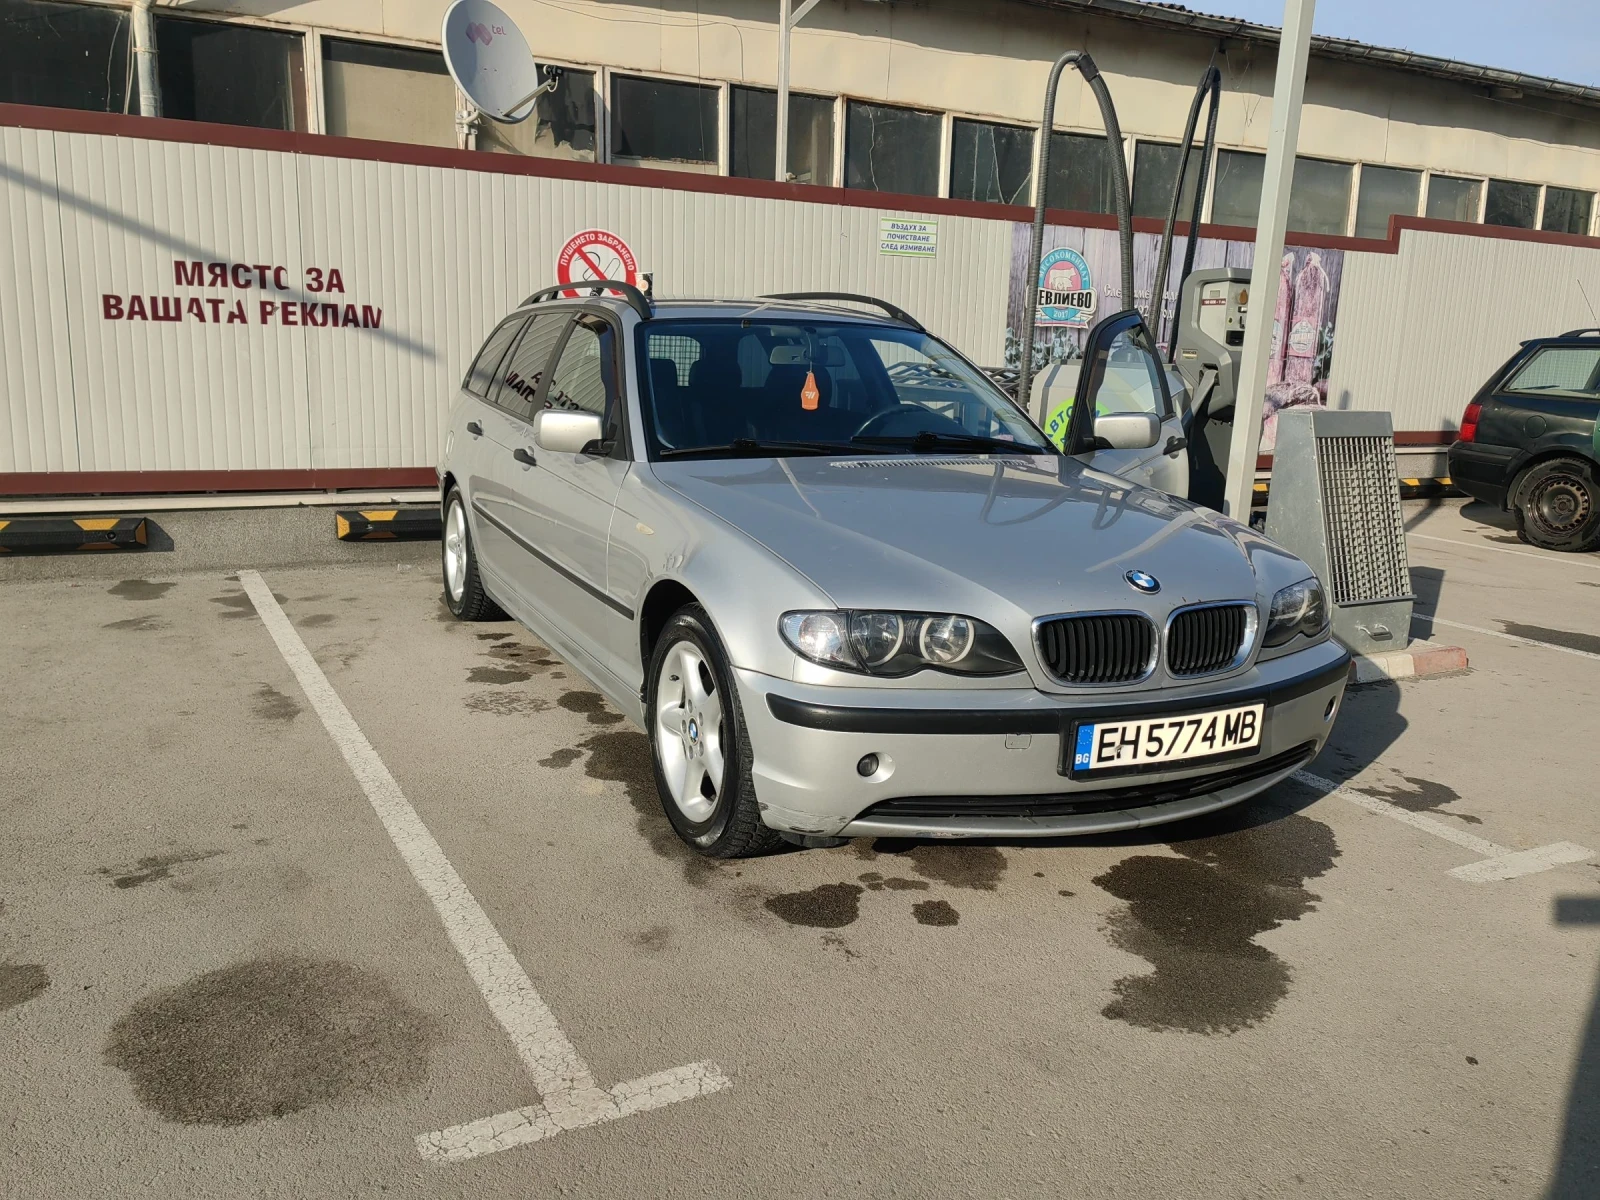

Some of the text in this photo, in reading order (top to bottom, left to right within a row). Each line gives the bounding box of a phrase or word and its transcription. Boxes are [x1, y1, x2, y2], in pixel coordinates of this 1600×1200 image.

[890, 222, 918, 231] ВЪЗДУХ
[886, 232, 930, 242] ПОЧИСТВАНЕ
[560, 233, 635, 271] ПУШЕНЕТО ЗАБРАНЕНО
[880, 243, 936, 253] СЛЕД ИЗМИВАНЕ
[305, 266, 346, 294] ЗА
[1037, 289, 1093, 309] ЕВЛИЕВО
[102, 293, 249, 325] ВАШАТА
[1053, 310, 1069, 318] 2017
[1075, 753, 1089, 765] BG
